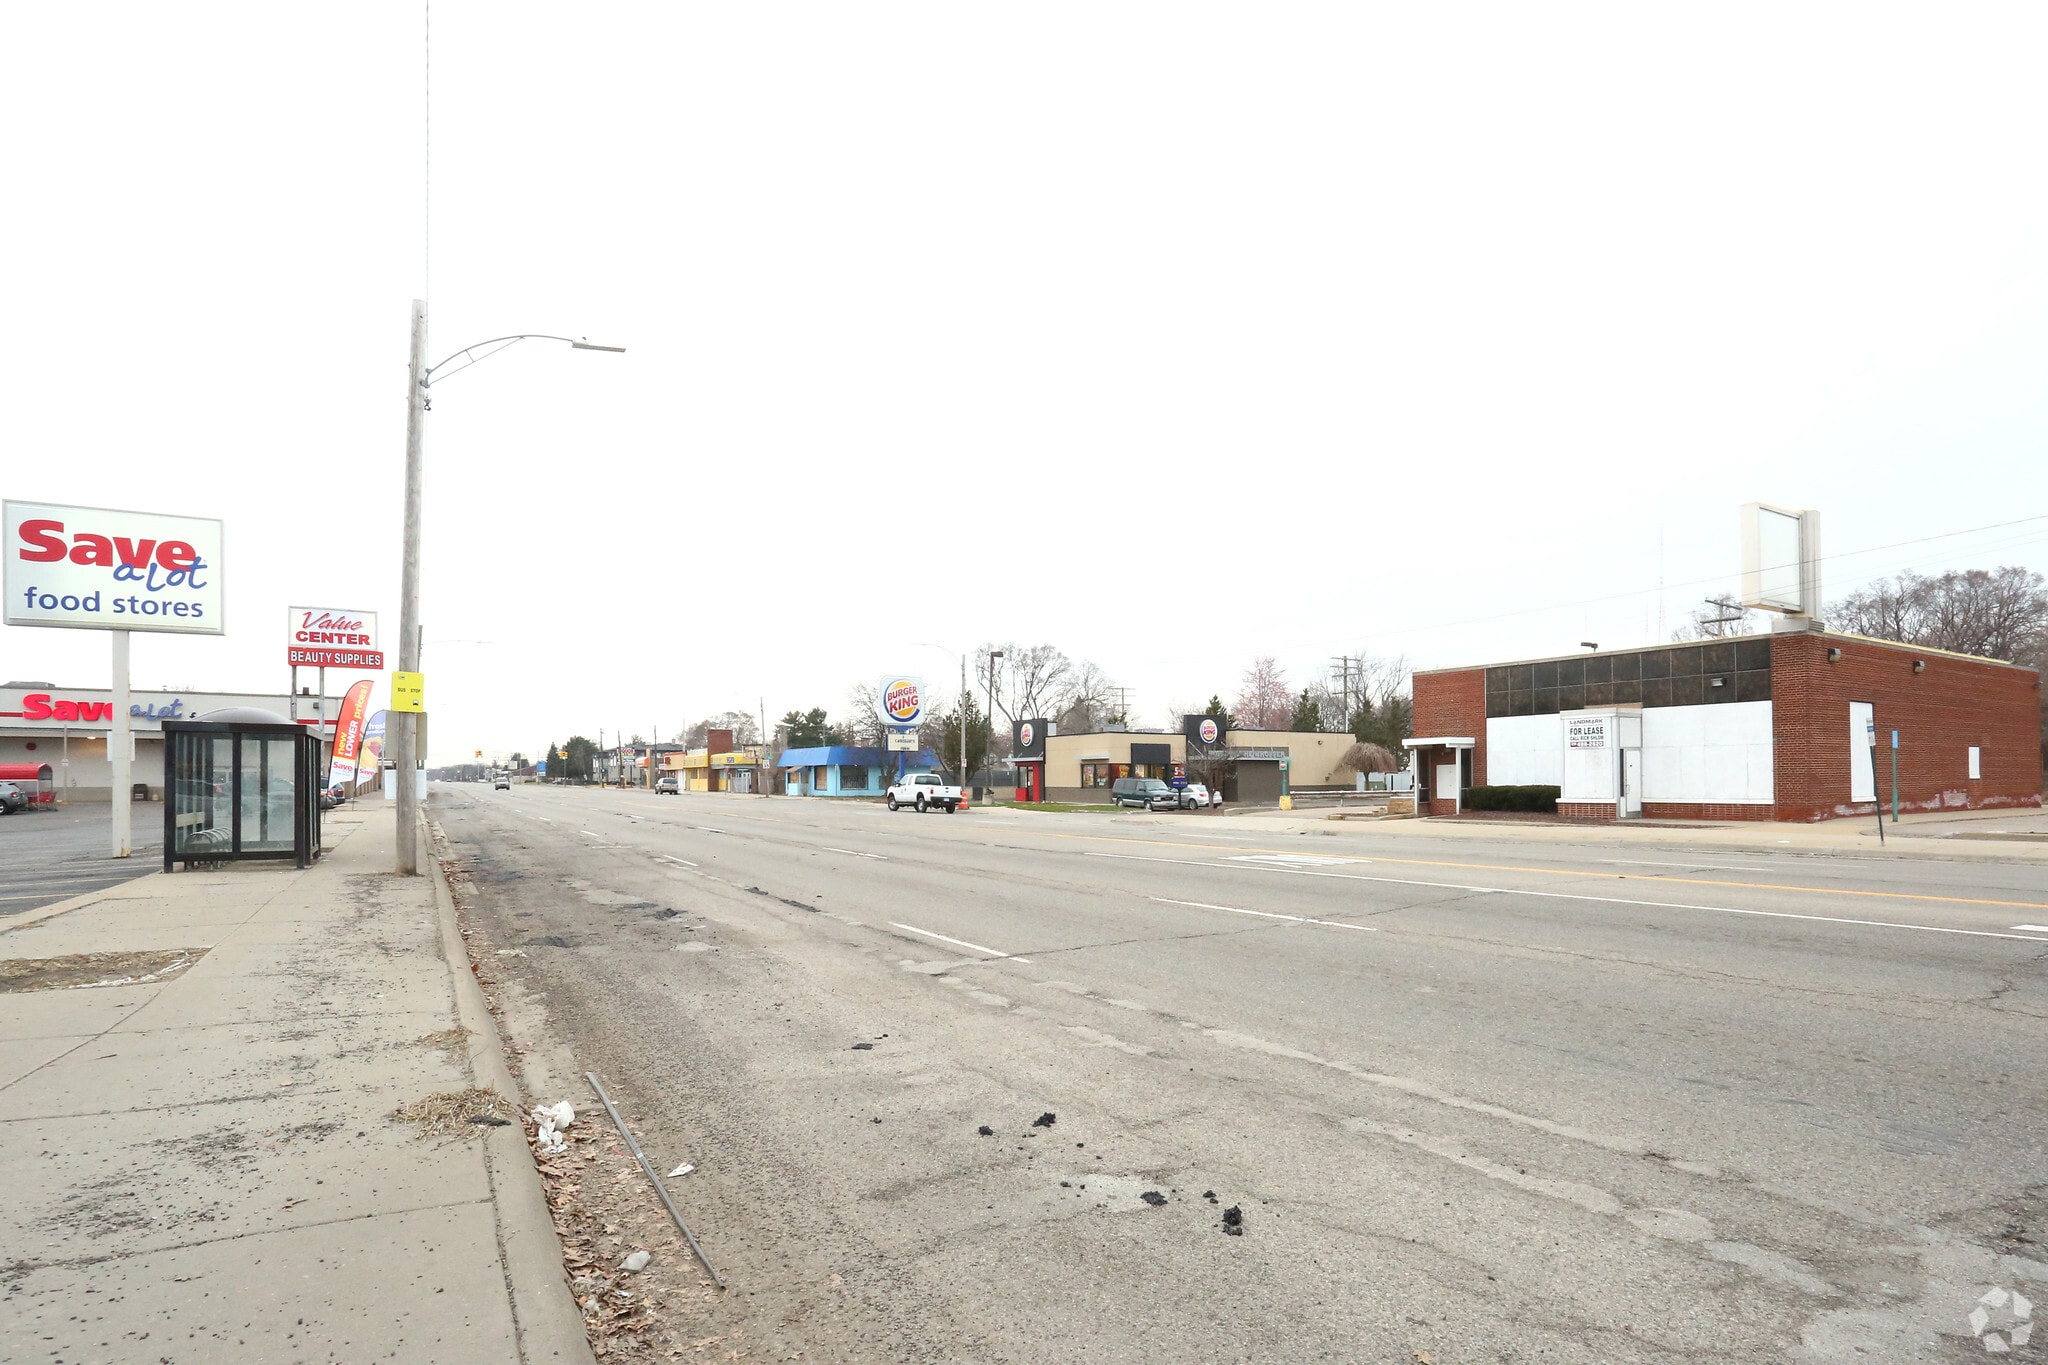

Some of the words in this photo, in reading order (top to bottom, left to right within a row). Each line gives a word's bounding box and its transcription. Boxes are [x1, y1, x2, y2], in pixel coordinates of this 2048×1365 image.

[18, 519, 196, 572] Save
[24, 586, 100, 612] food
[113, 595, 204, 618] stores
[302, 611, 363, 630] Value
[295, 631, 370, 645] CENTER
[290, 650, 332, 664] BEAUTY
[334, 654, 381, 666] SUPPLIES
[888, 686, 917, 701] BURGER
[890, 695, 918, 713] KING
[344, 720, 359, 757] LOWER
[353, 685, 369, 719] prices!
[1570, 727, 1582, 735] FOR
[337, 732, 347, 755] new
[333, 761, 353, 771] Save
